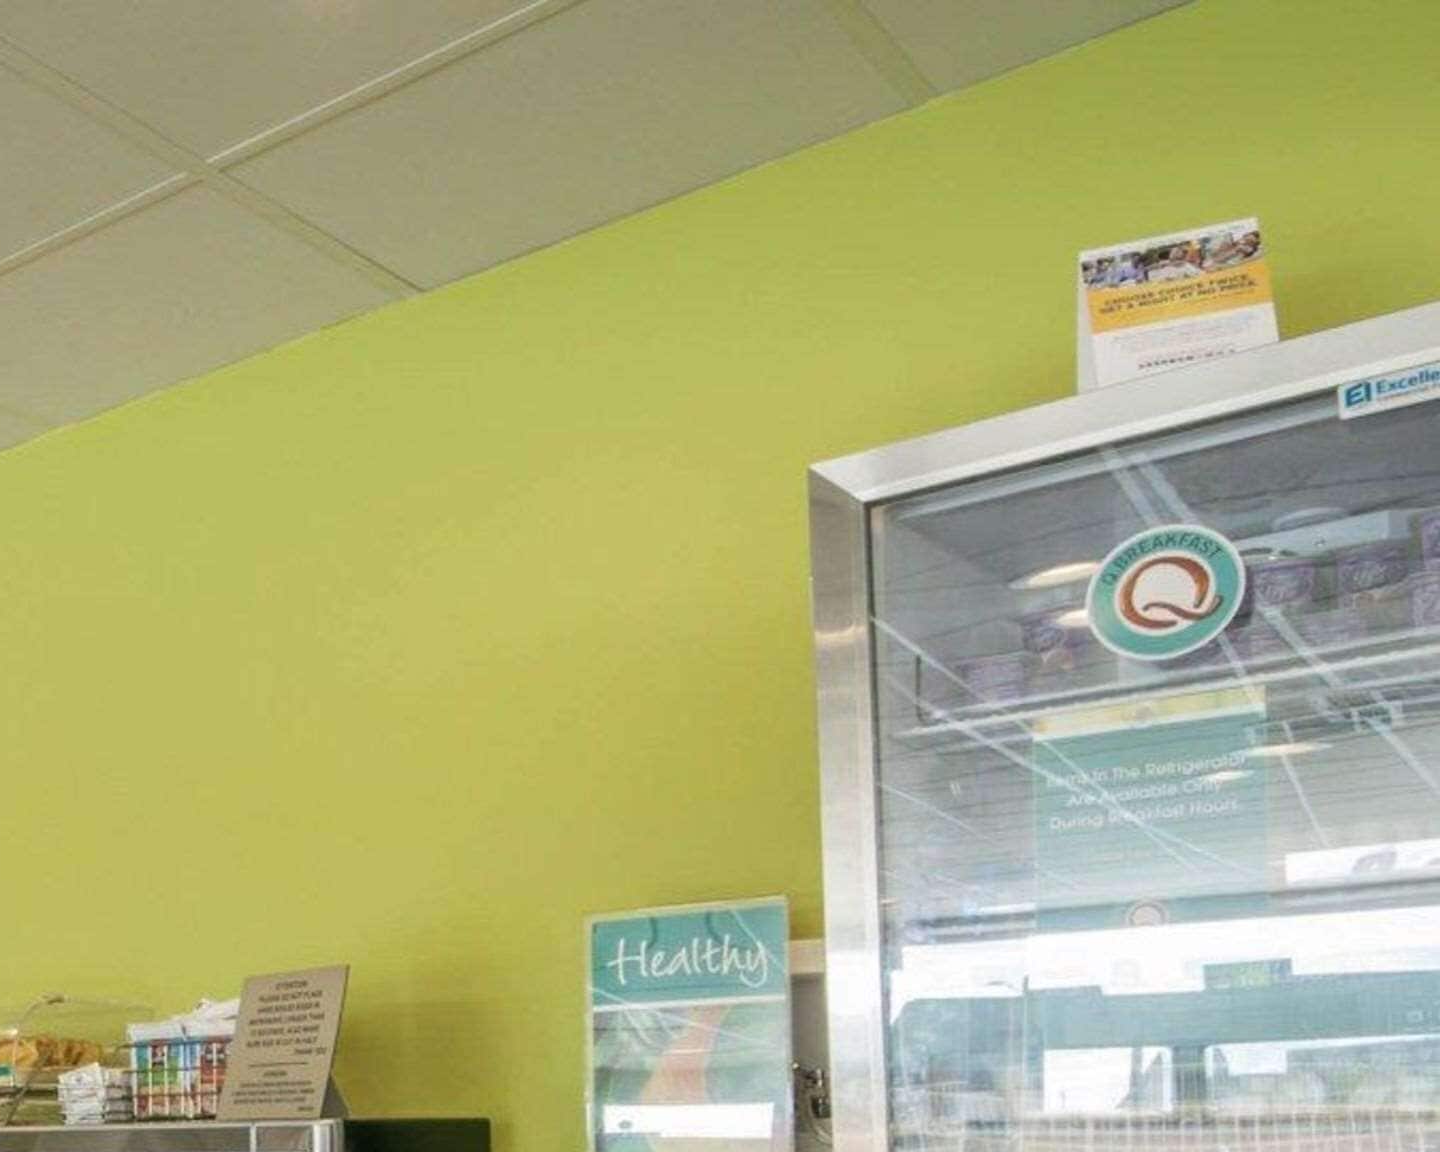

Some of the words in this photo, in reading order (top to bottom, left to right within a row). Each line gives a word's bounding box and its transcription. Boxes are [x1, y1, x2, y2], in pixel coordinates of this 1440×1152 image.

[1110, 531, 1223, 572] BREAKFAST
[1144, 751, 1247, 777] Refrigerator
[1048, 814, 1105, 833] During
[606, 933, 769, 989] Healthy
